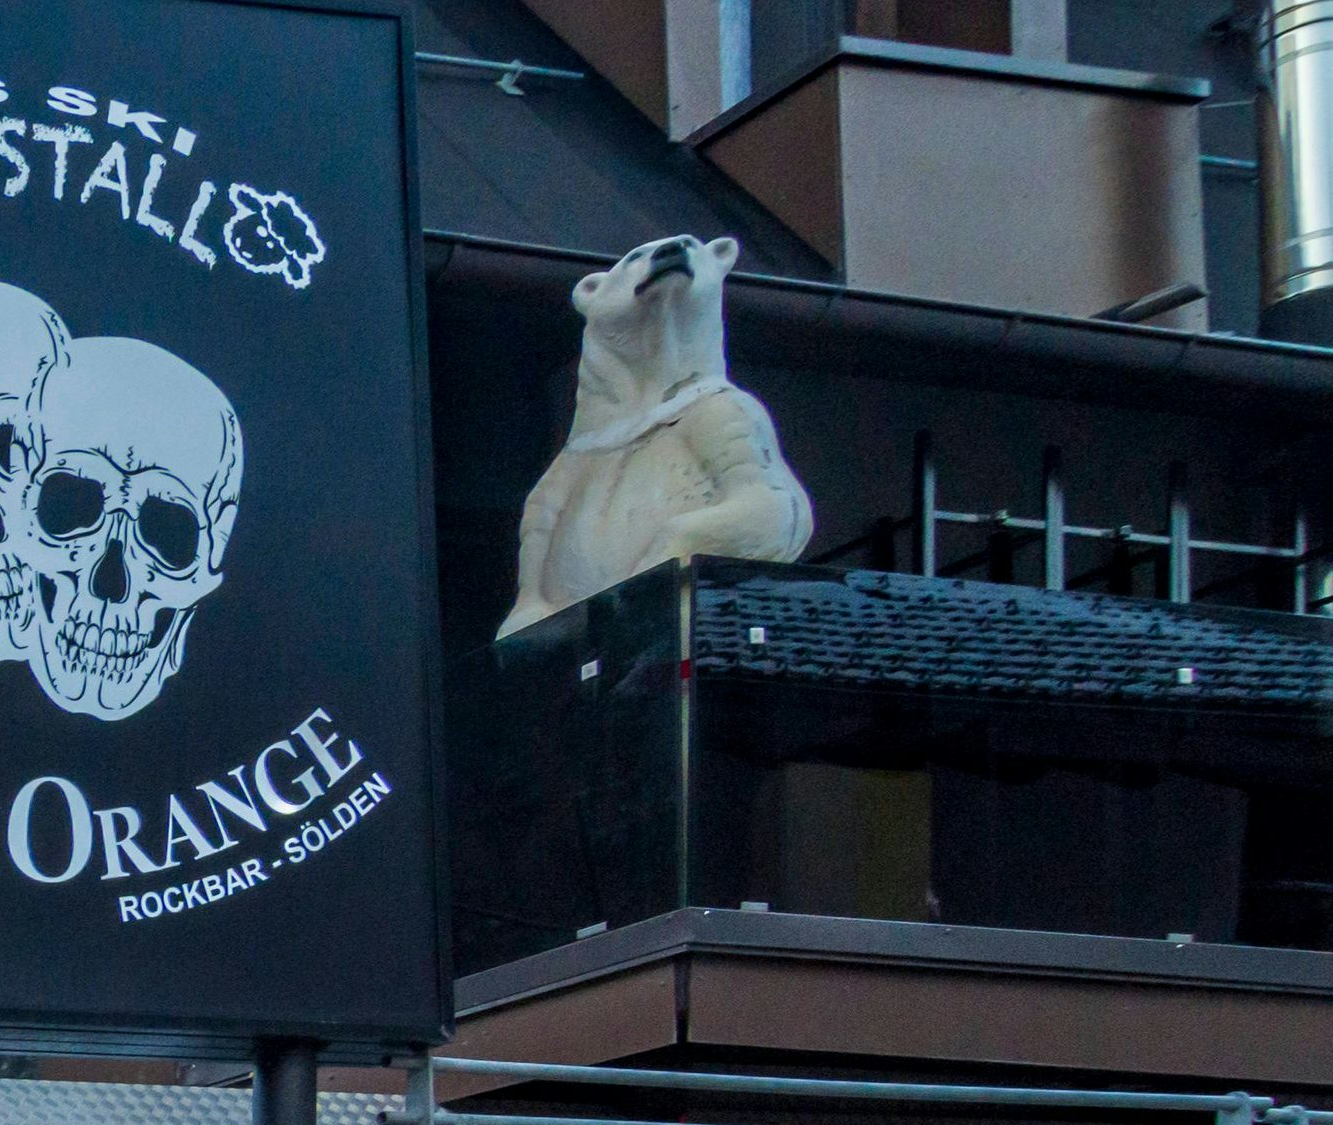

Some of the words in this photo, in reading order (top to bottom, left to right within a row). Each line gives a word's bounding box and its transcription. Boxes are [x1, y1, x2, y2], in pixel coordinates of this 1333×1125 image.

[46, 86, 198, 157] SKI
[118, 857, 269, 922] ROCKBAR
[284, 771, 392, 865] SÖLDEN
